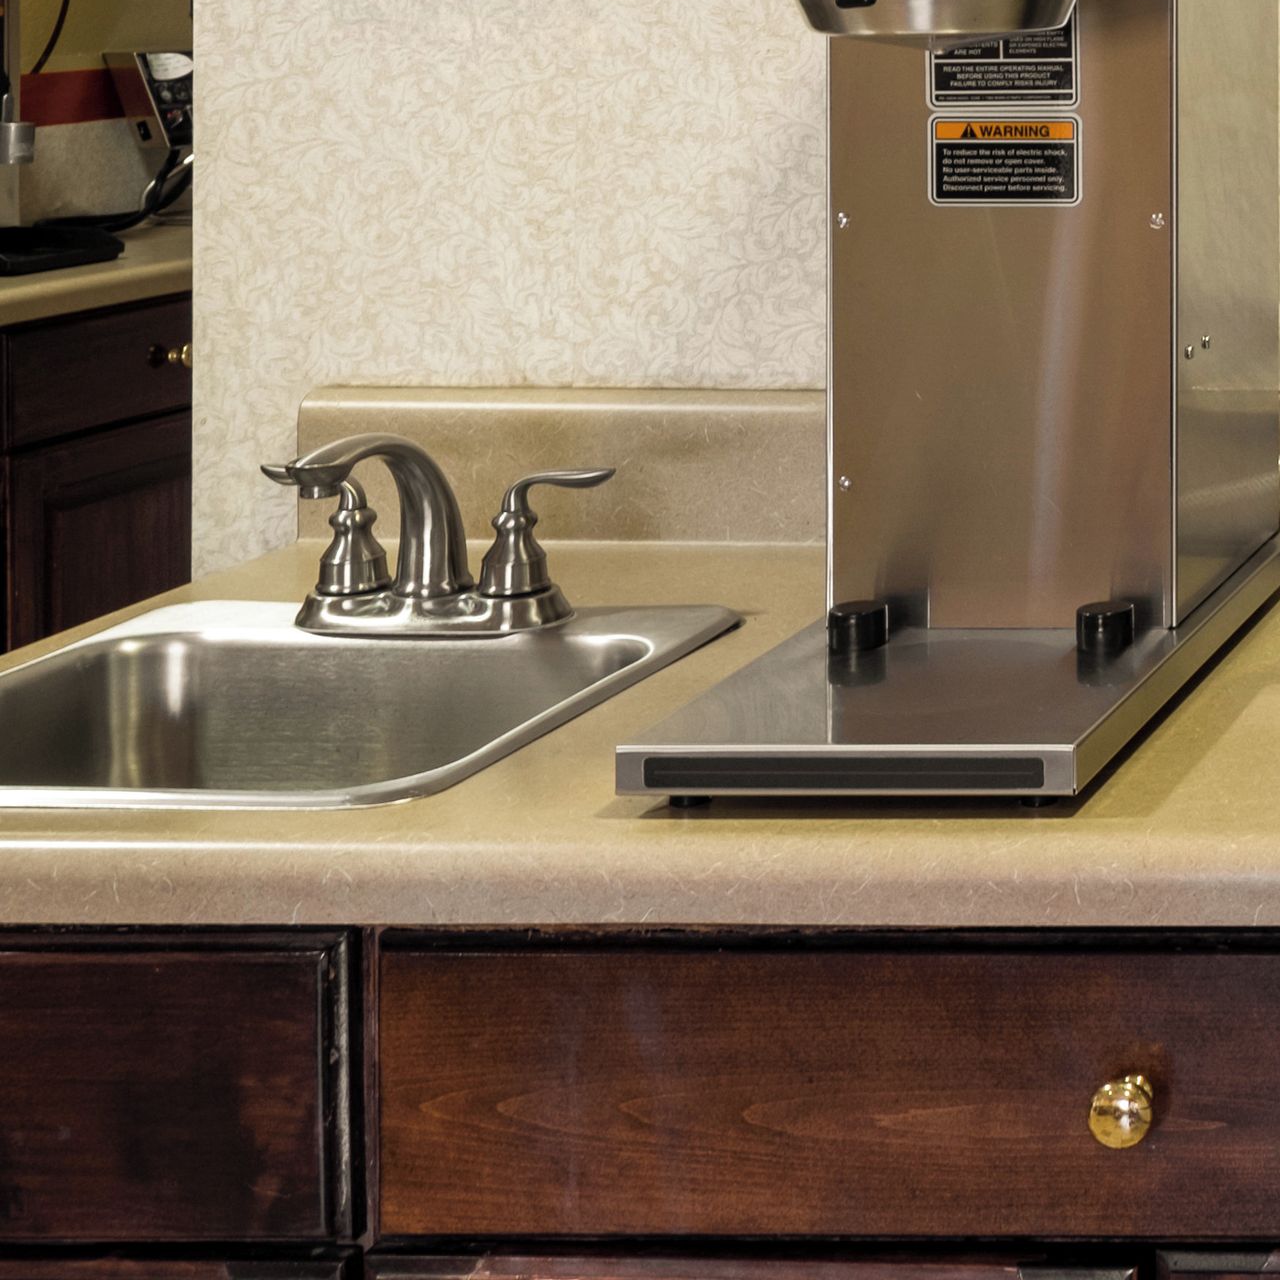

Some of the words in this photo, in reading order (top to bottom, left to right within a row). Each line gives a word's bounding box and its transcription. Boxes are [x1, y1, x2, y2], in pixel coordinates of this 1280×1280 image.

[979, 125, 1050, 137] WARNING
[942, 148, 952, 156] To
[953, 148, 977, 156] reduce
[979, 148, 991, 156] the
[992, 148, 1006, 156] risk
[1007, 148, 1015, 156] of
[1016, 148, 1042, 156] electric
[942, 157, 952, 165] do
[953, 157, 966, 165] not
[942, 166, 953, 174] No
[1014, 167, 1033, 175] parts
[942, 175, 982, 183] Authorized
[983, 175, 1009, 183] service
[1010, 175, 1046, 184] personnel
[942, 184, 983, 192] Disconnect
[984, 185, 1006, 193] power
[1007, 184, 1031, 192] before
